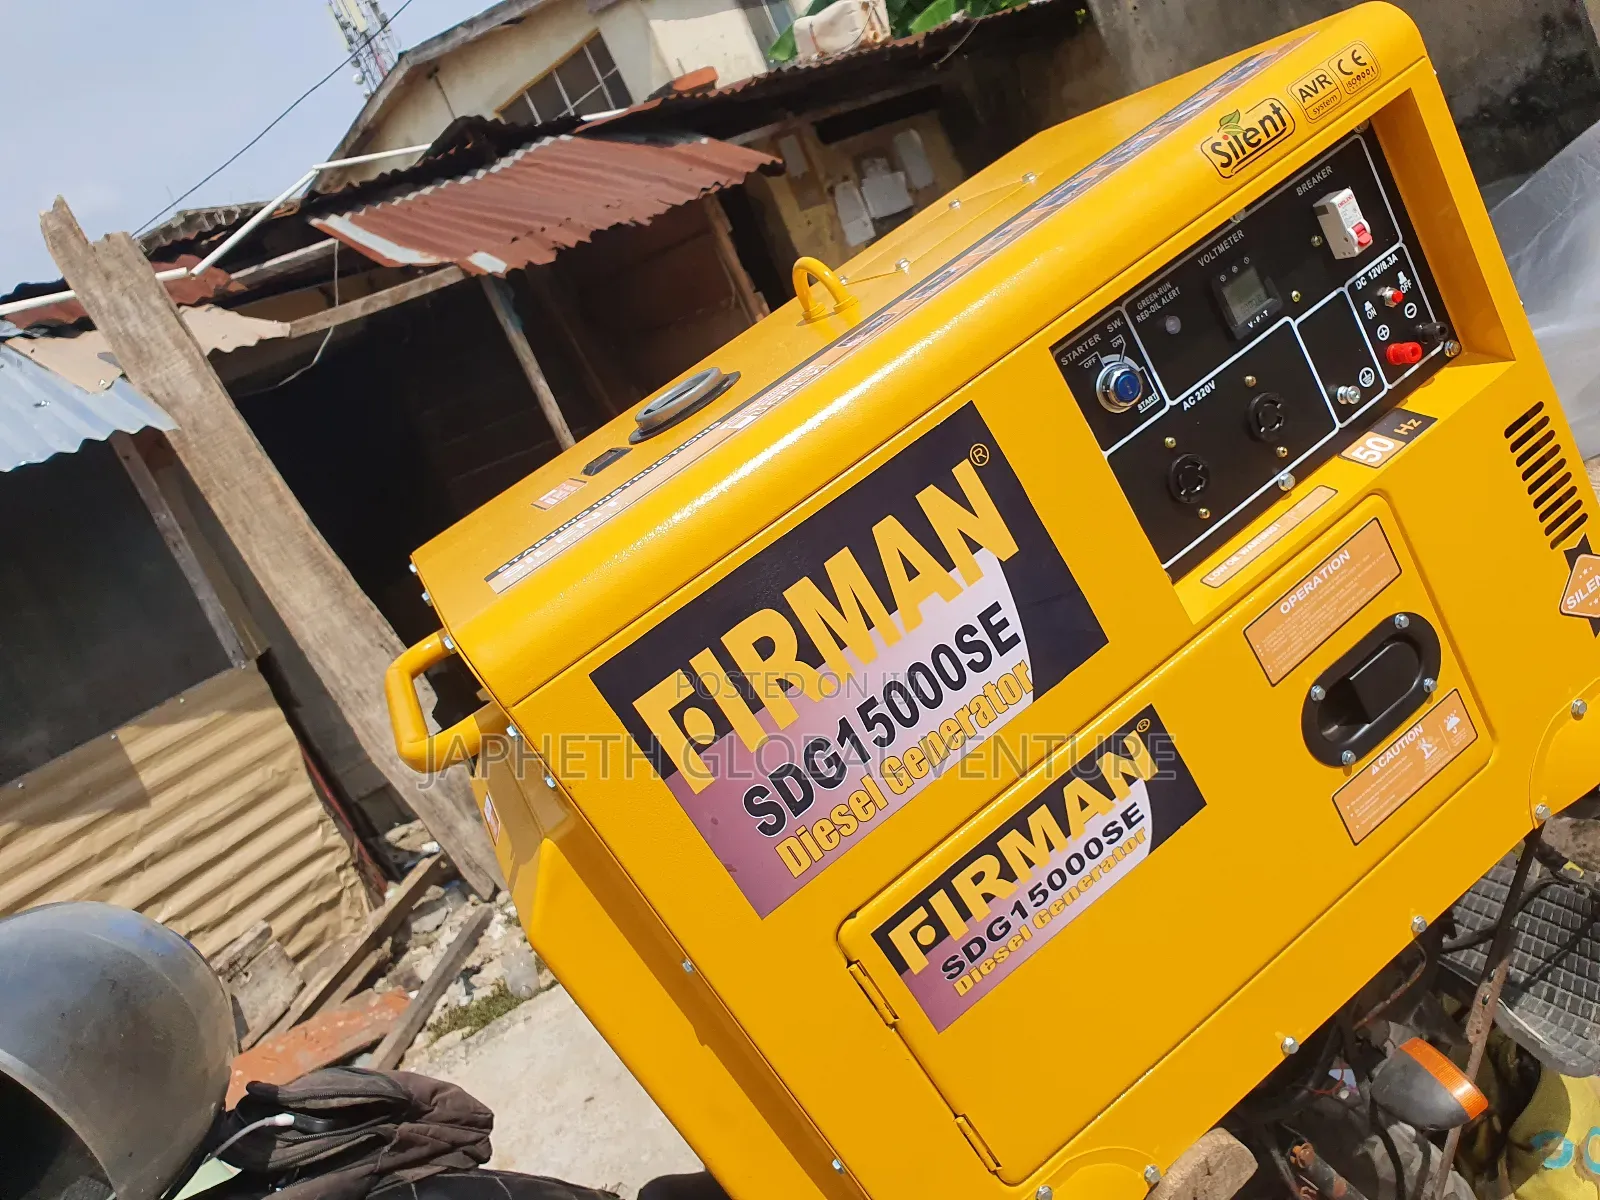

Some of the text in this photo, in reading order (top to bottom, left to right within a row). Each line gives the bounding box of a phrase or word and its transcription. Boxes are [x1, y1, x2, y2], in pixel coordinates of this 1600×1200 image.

[1298, 73, 1333, 103] AVR
[1312, 94, 1338, 115] system
[1211, 102, 1287, 168] Silent
[1296, 165, 1333, 196] BREAKER
[1198, 230, 1245, 267] VOLTMETER
[1137, 281, 1172, 310] GREEN-RUN
[1355, 277, 1367, 290] DC
[1400, 280, 1412, 294] OFF
[1136, 287, 1181, 323] RED-OIL ALERT
[1366, 309, 1378, 320] ON
[1060, 317, 1124, 366] STARTER SW.
[1112, 338, 1123, 348] ON
[1083, 356, 1097, 369] OFF
[1137, 393, 1158, 411] START
[1182, 380, 1217, 411] AC 220V
[1352, 418, 1422, 463] 50 Hz
[1279, 549, 1351, 614] OPERATION
[632, 458, 1019, 795] FIRMAN
[742, 599, 1022, 838] SDG15000SE
[1378, 723, 1424, 768] CAUTION
[774, 660, 1034, 880] Diesel Generator
[887, 730, 1159, 975] FIRMAN
[941, 802, 1145, 981] SDG15000SE
[952, 827, 1148, 997] Diesel Generator
